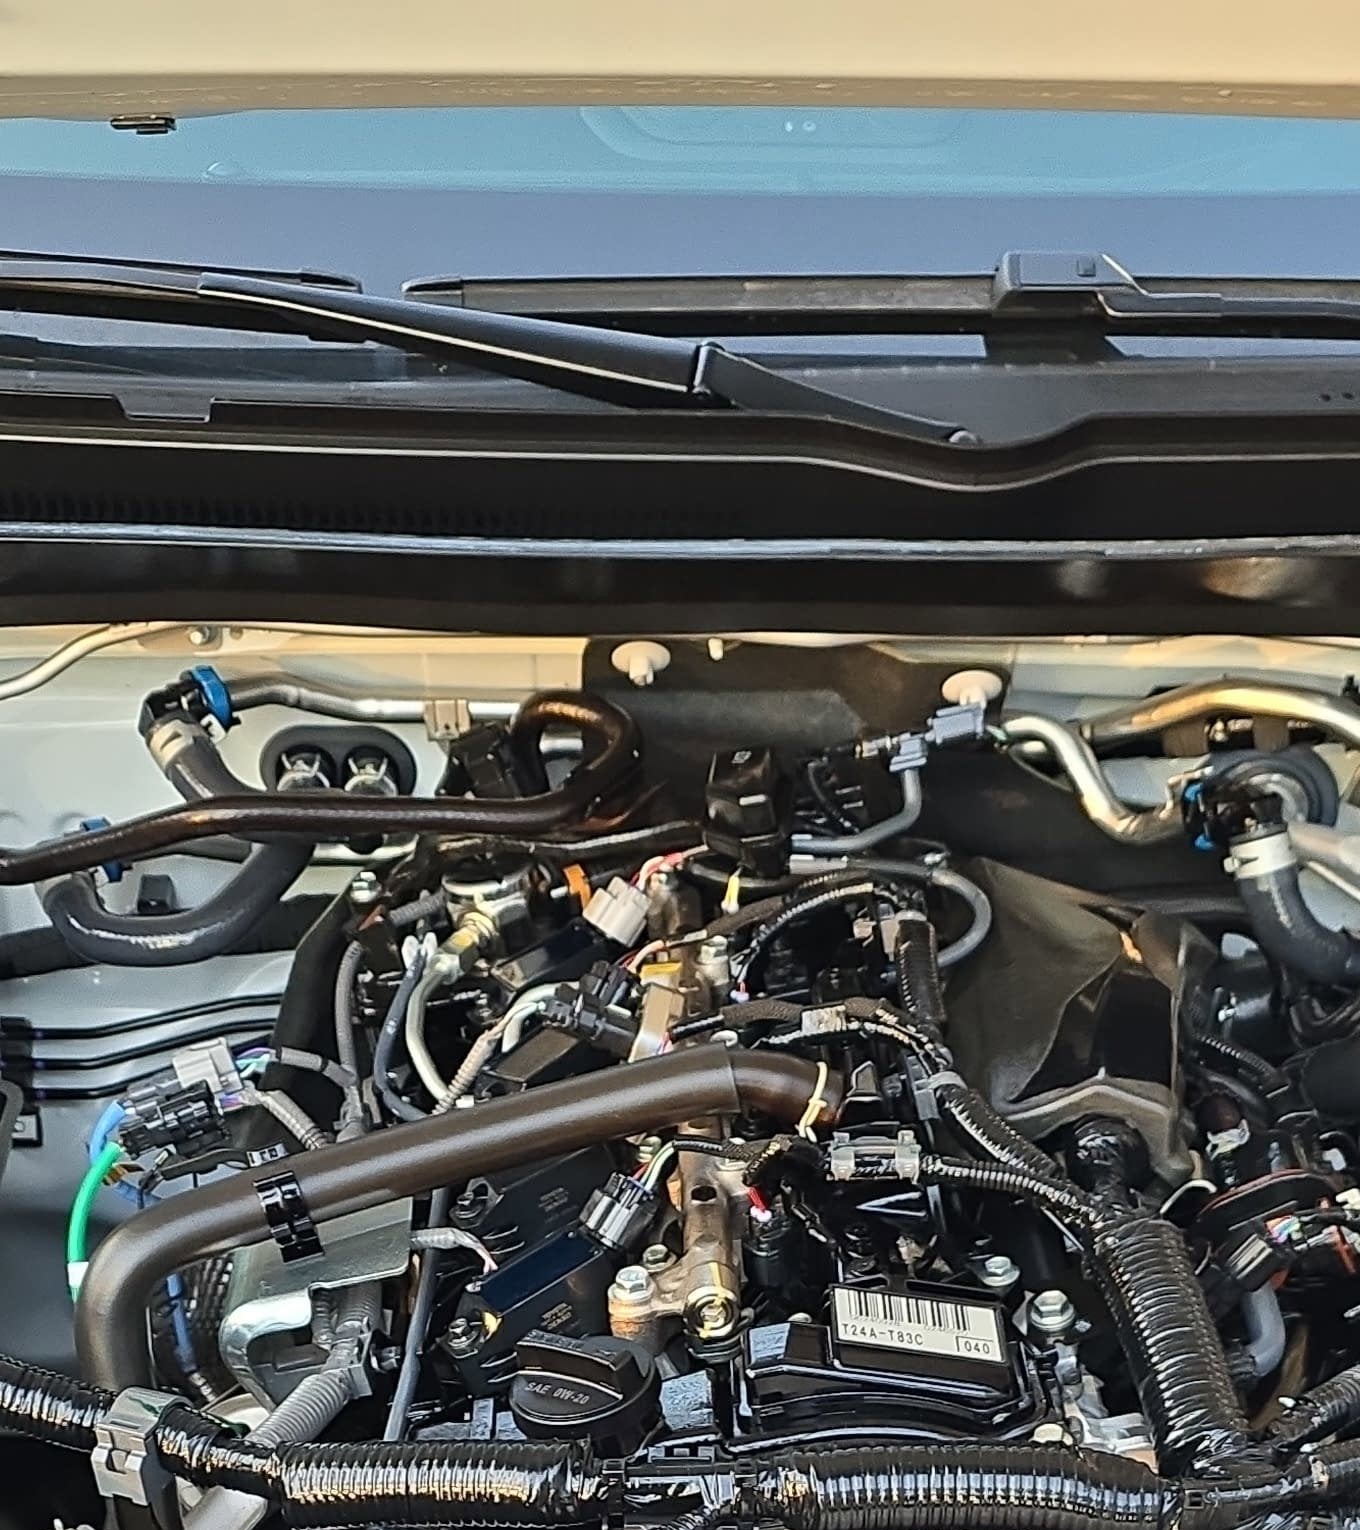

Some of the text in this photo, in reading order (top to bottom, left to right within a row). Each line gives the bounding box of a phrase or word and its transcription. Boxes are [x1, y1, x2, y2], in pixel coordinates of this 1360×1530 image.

[842, 1322, 925, 1346] T24A-T83C
[524, 1382, 591, 1405] SAE 0W-20
